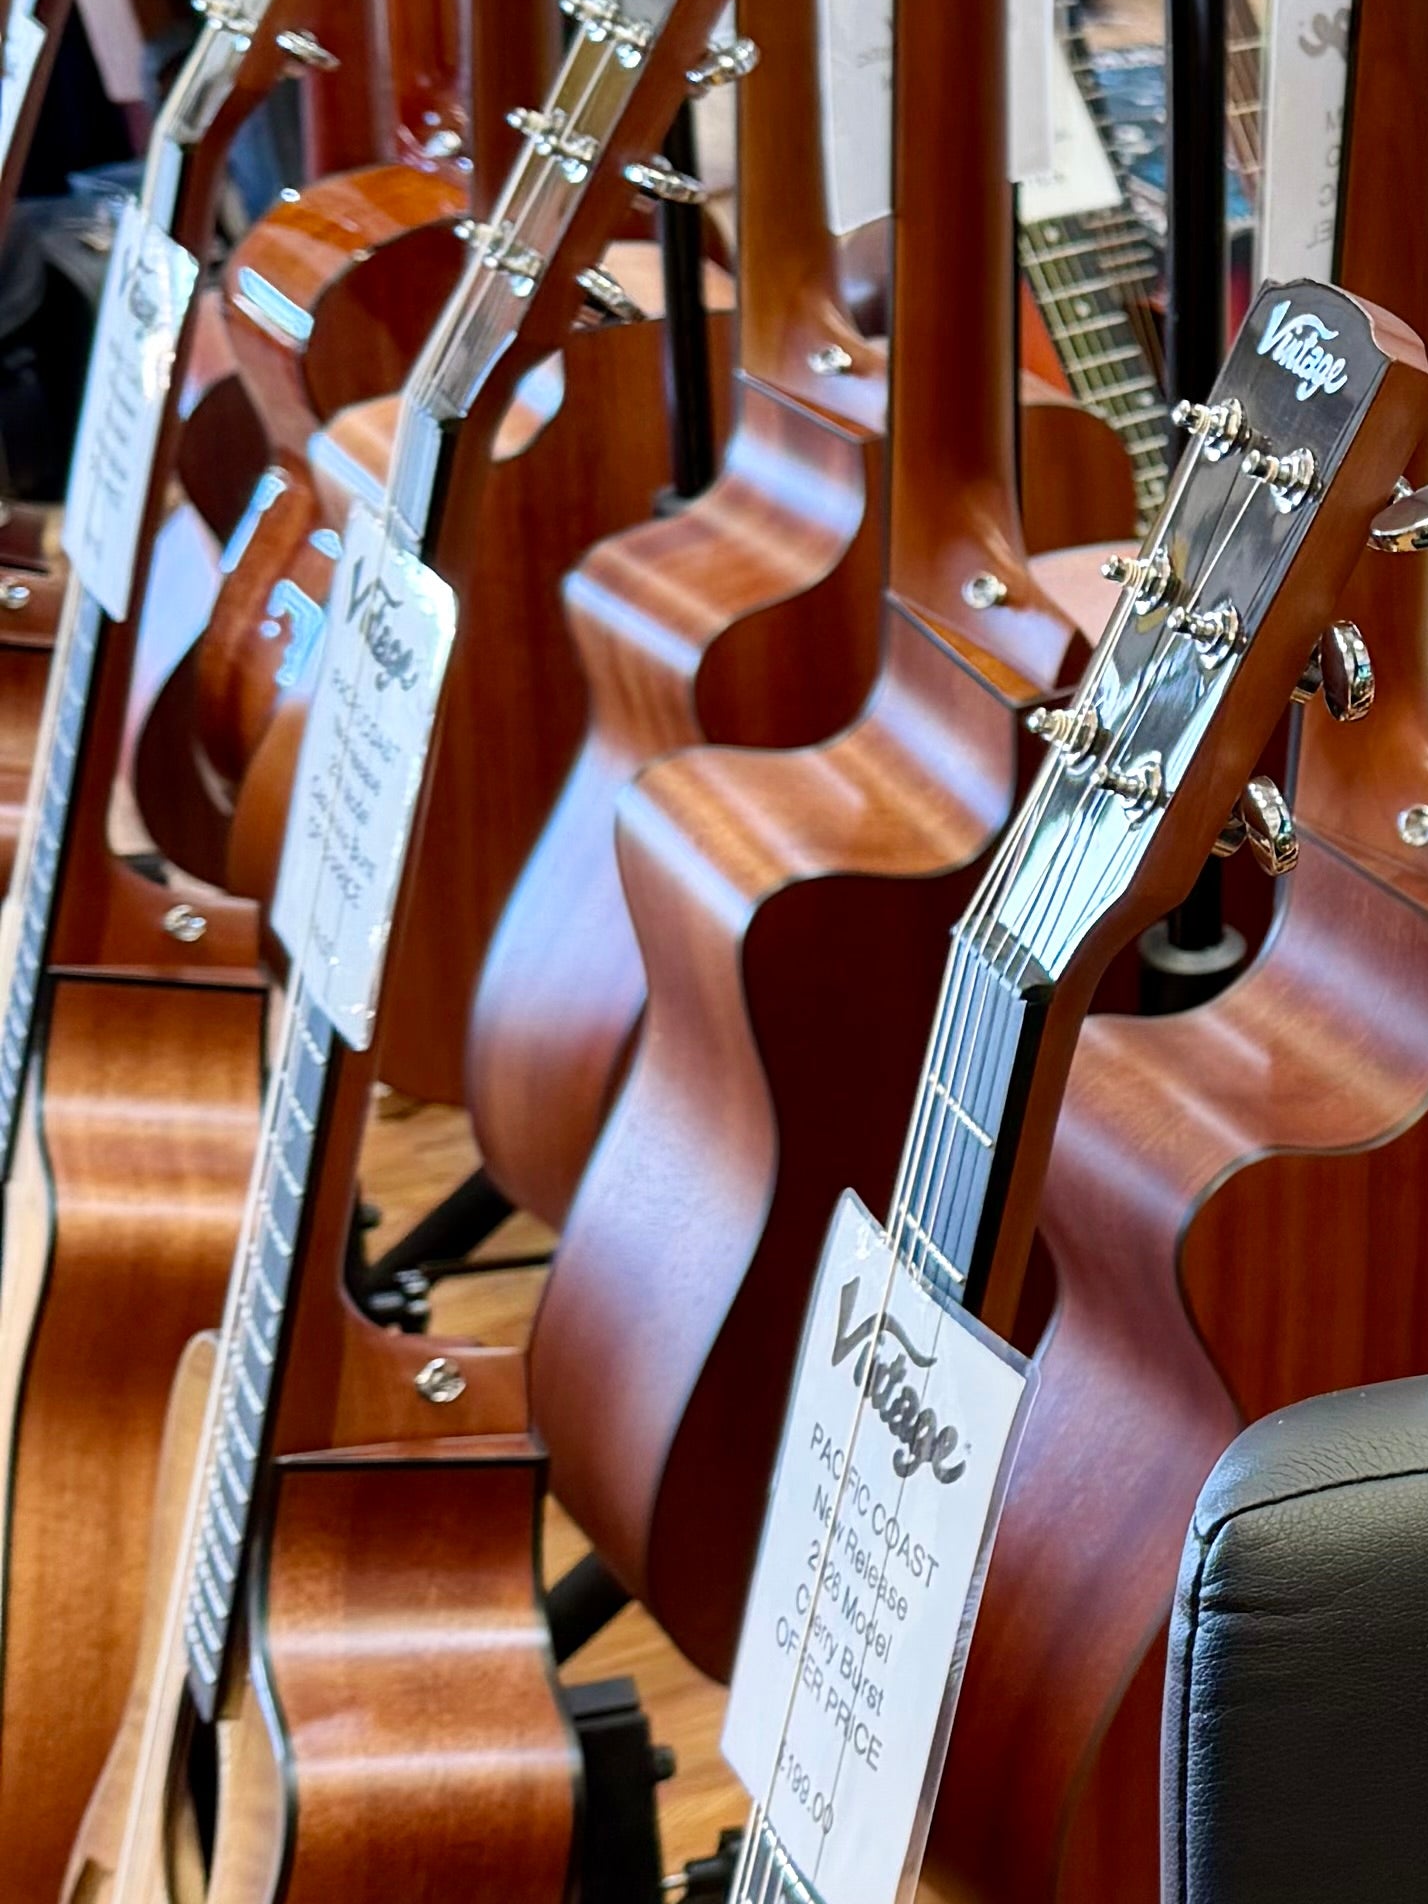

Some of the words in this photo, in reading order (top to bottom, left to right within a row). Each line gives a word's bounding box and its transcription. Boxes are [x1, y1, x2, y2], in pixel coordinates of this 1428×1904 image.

[1256, 299, 1349, 401] Vintage
[831, 1276, 967, 1485] Vintage
[812, 1484, 846, 1540] New
[843, 1530, 909, 1622] Release
[871, 1502, 939, 1588] COAST
[795, 1582, 839, 1669] Cerry
[839, 1650, 885, 1717] Burst
[806, 1547, 842, 1603] 226
[841, 1585, 894, 1665] Model
[824, 1688, 884, 1772] PRICE
